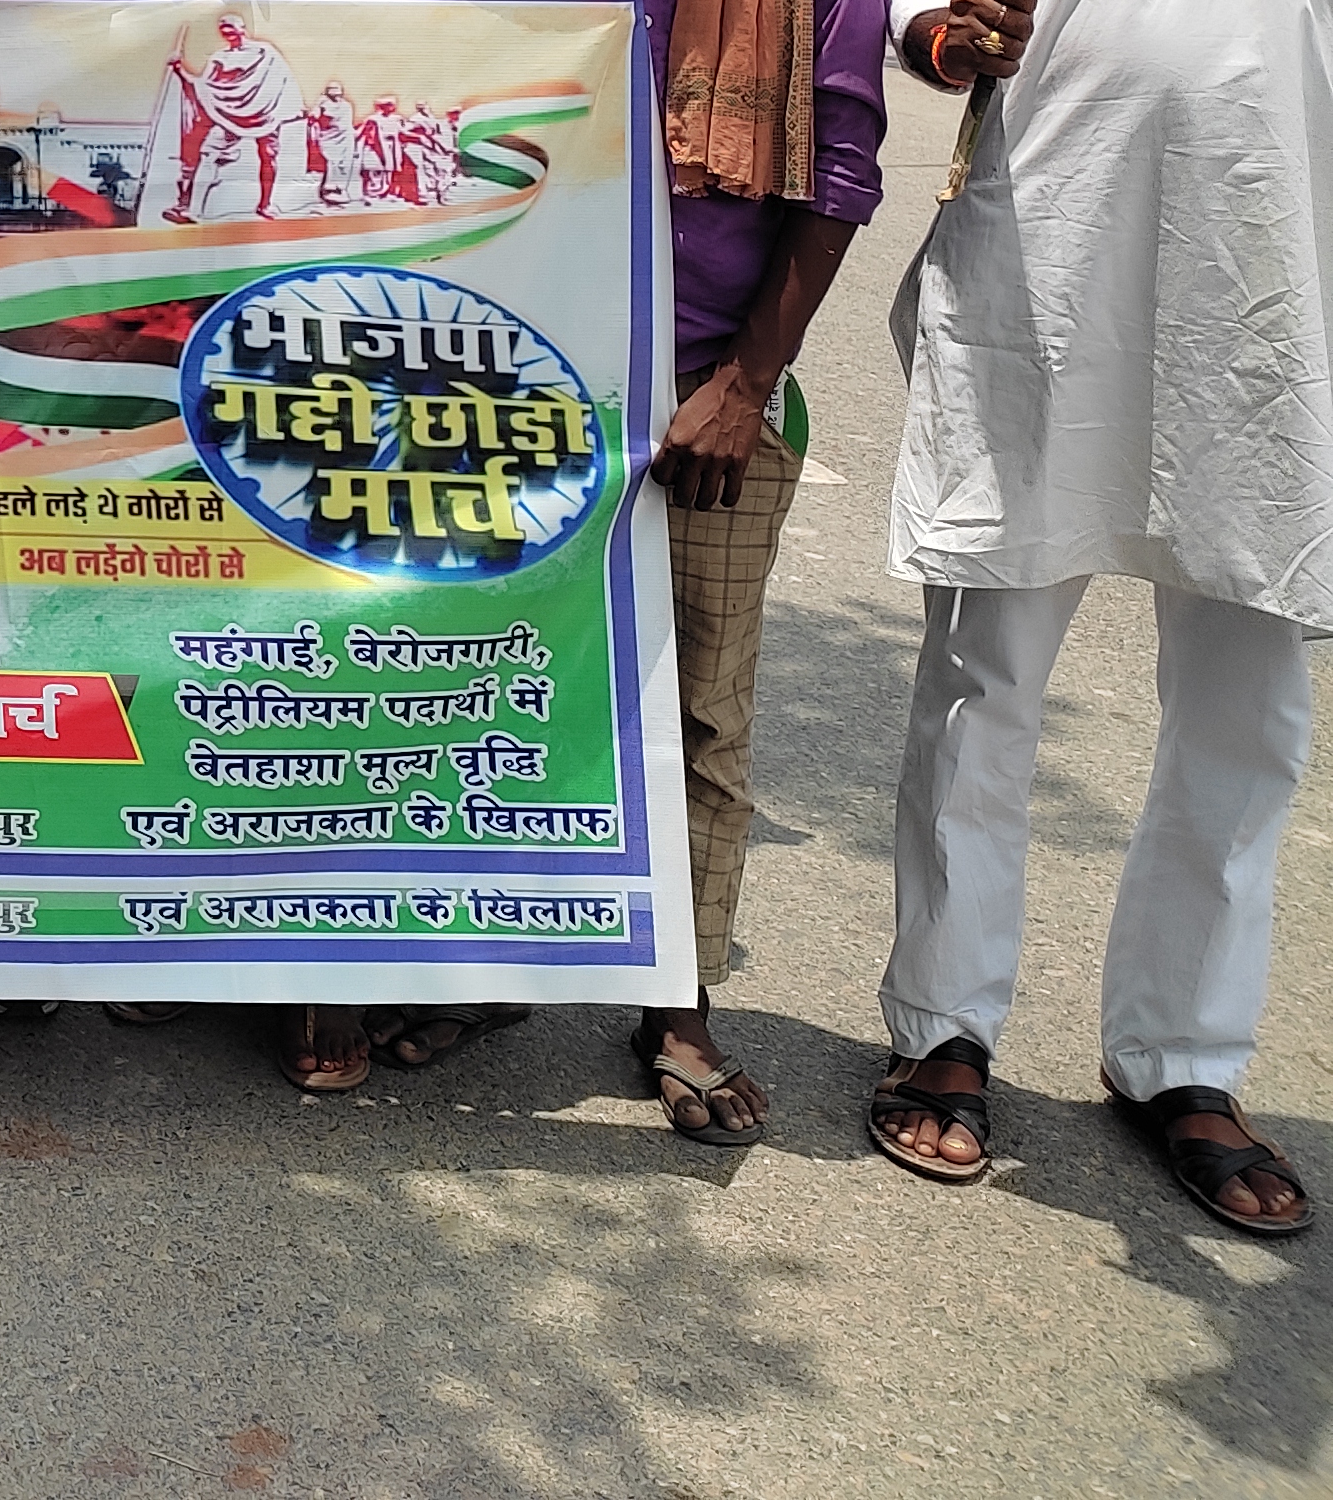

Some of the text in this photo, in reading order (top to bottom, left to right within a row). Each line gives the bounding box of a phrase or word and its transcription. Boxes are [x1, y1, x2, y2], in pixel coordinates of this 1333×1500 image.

[241, 305, 521, 375] भाजपा
[210, 373, 595, 469] गद्दी छोड़ो
[43, 487, 88, 524] लड़े
[98, 488, 119, 518] थे
[125, 489, 191, 521] गोरों
[196, 491, 224, 522] से
[317, 456, 526, 542] मार्च
[19, 547, 68, 575] अब
[154, 545, 210, 579] चोरों
[217, 547, 245, 579] से
[174, 624, 547, 676] महंगाई, बेरोजगारी,
[511, 678, 549, 719] में
[191, 734, 543, 791] बेतहाशा मूल्य वृद्धि
[127, 794, 612, 845] एवं अराजकता के खिलाफ
[125, 889, 617, 934] एवं अराजकता के खिलाफ
